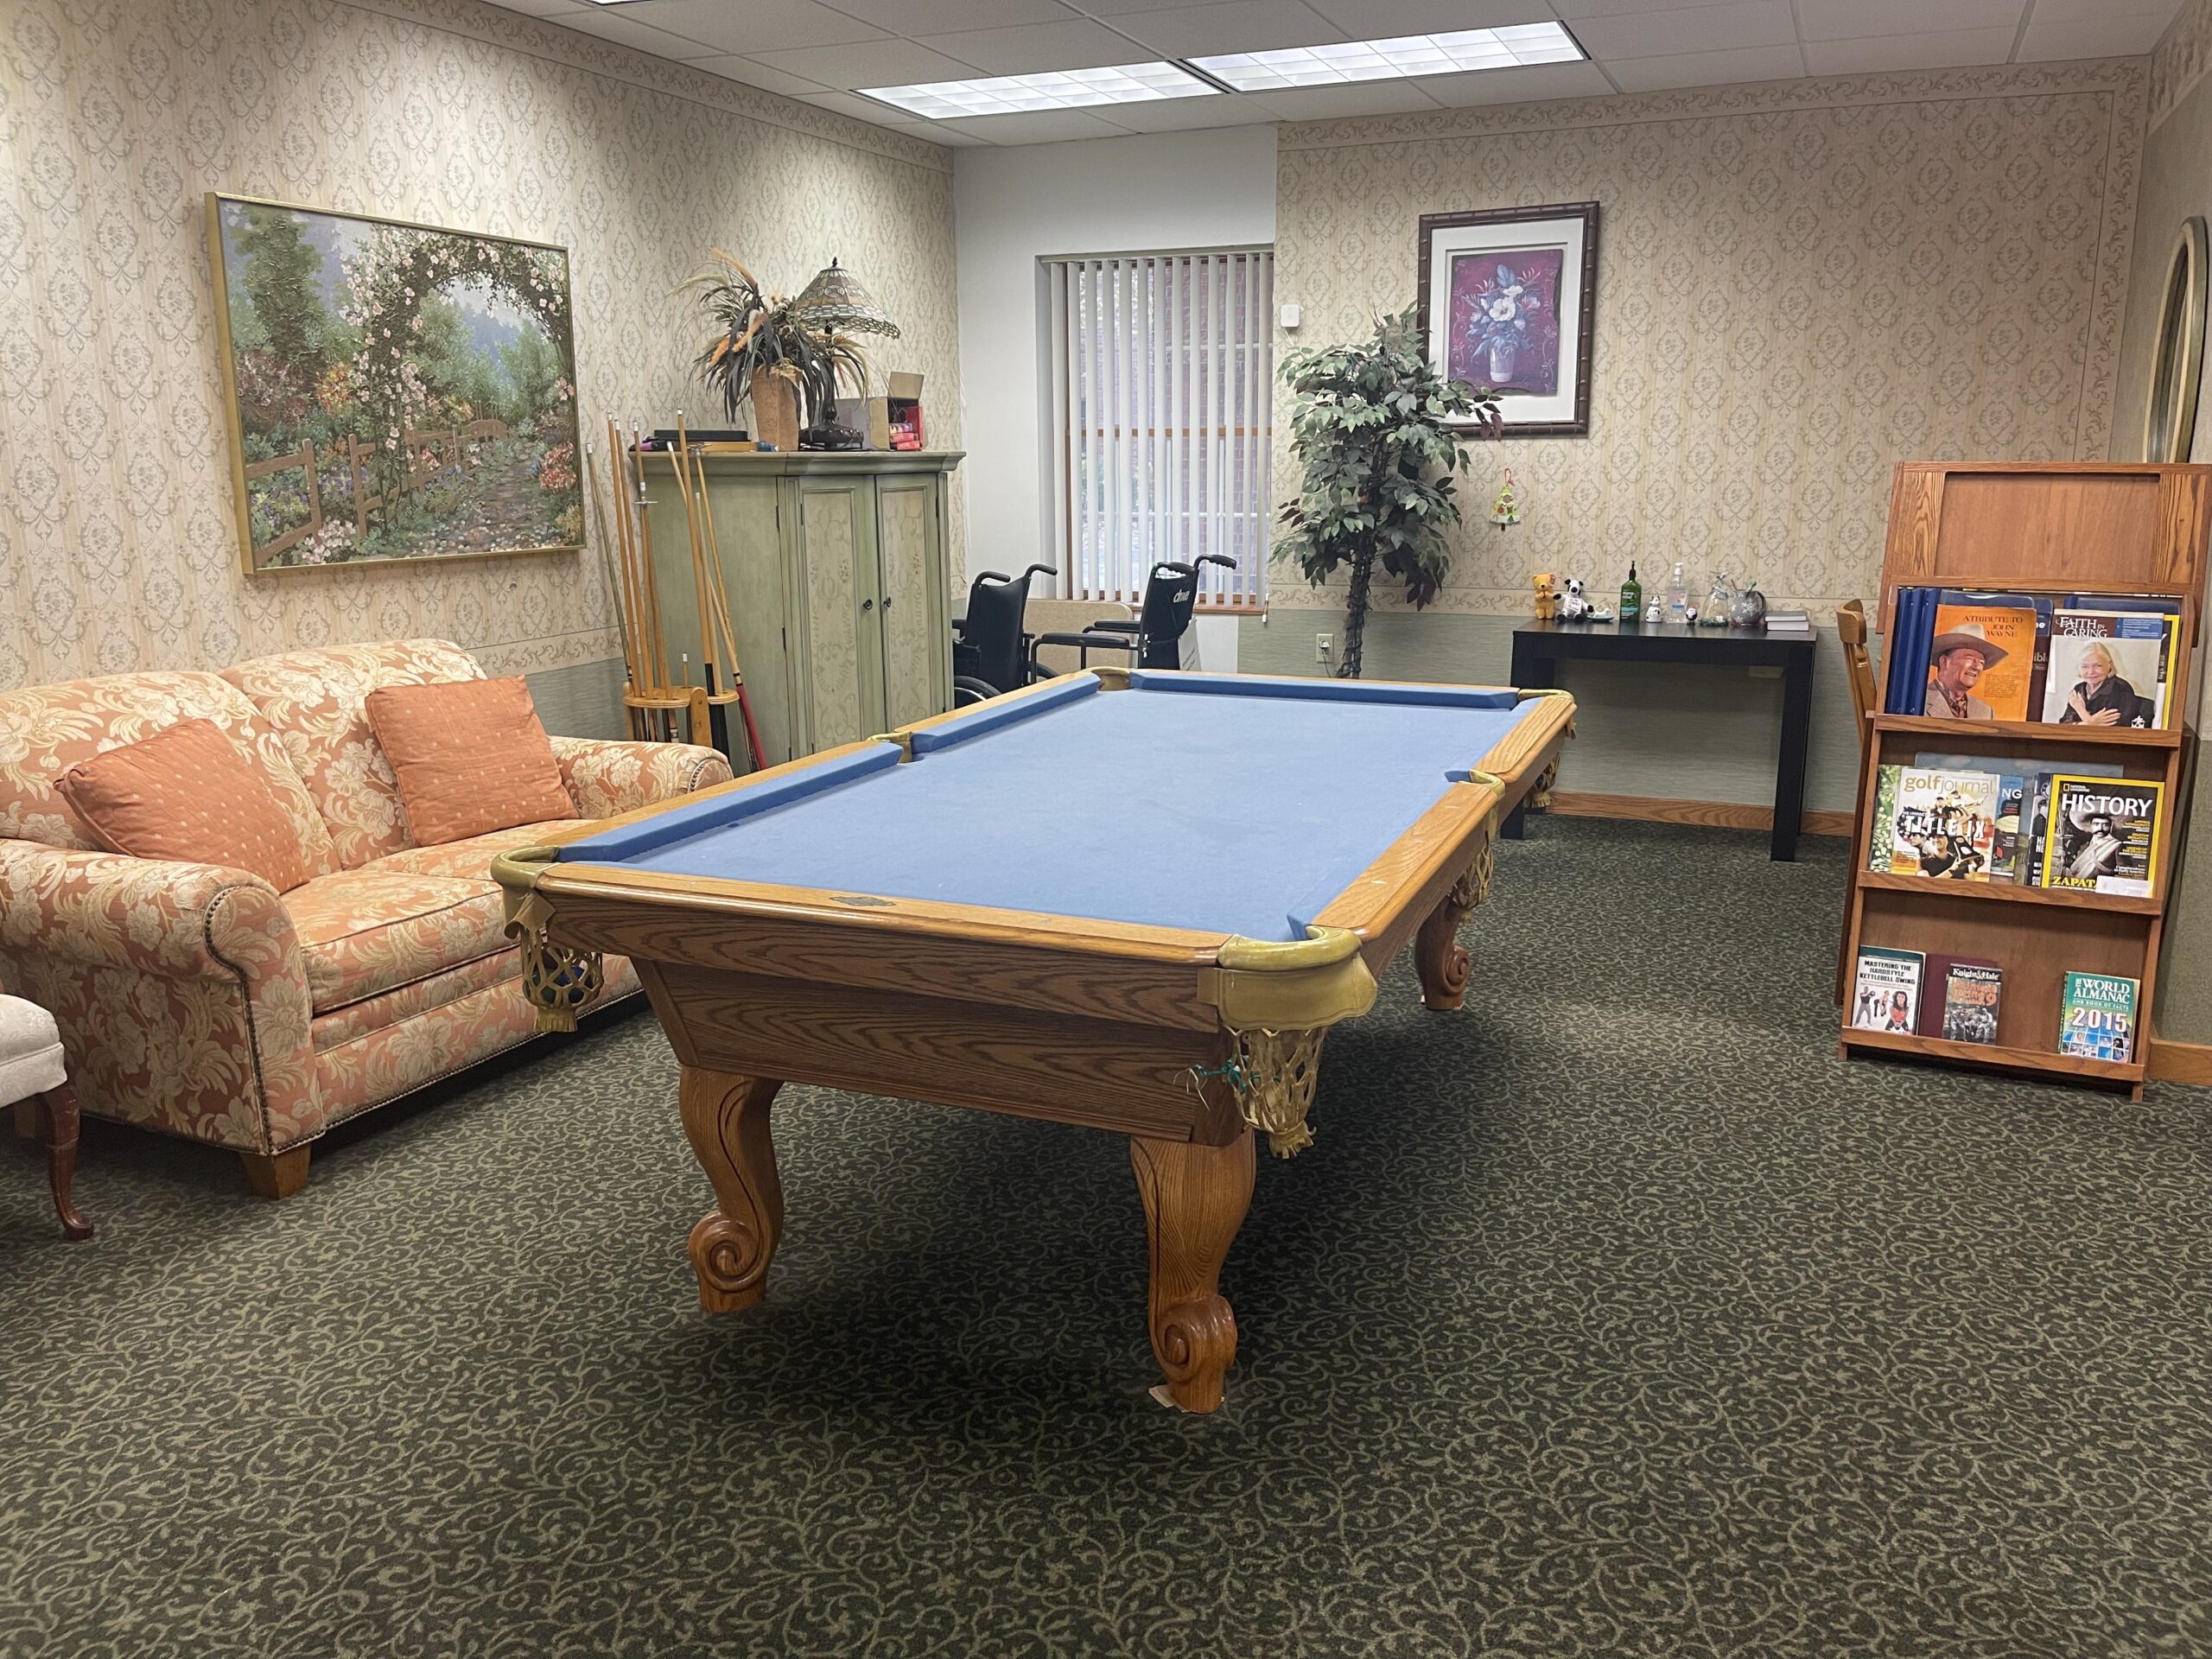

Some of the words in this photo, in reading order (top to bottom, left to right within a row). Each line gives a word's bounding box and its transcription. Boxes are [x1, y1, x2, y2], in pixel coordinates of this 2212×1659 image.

[2059, 616, 2098, 629] FAITH
[2063, 627, 2108, 639] CARING
[2062, 793, 2153, 817] HISTORY
[2053, 876, 2097, 887] ZAPAT
[1865, 960, 1898, 969] MASTERING
[1859, 972, 1893, 982] KETTLEBELL
[1895, 976, 1916, 985] SWING
[1869, 968, 1904, 976] HARDSTYLE
[2082, 978, 2130, 994] WORLD
[2073, 987, 2131, 1004] ALMANAC
[2072, 1007, 2127, 1033] 2015
